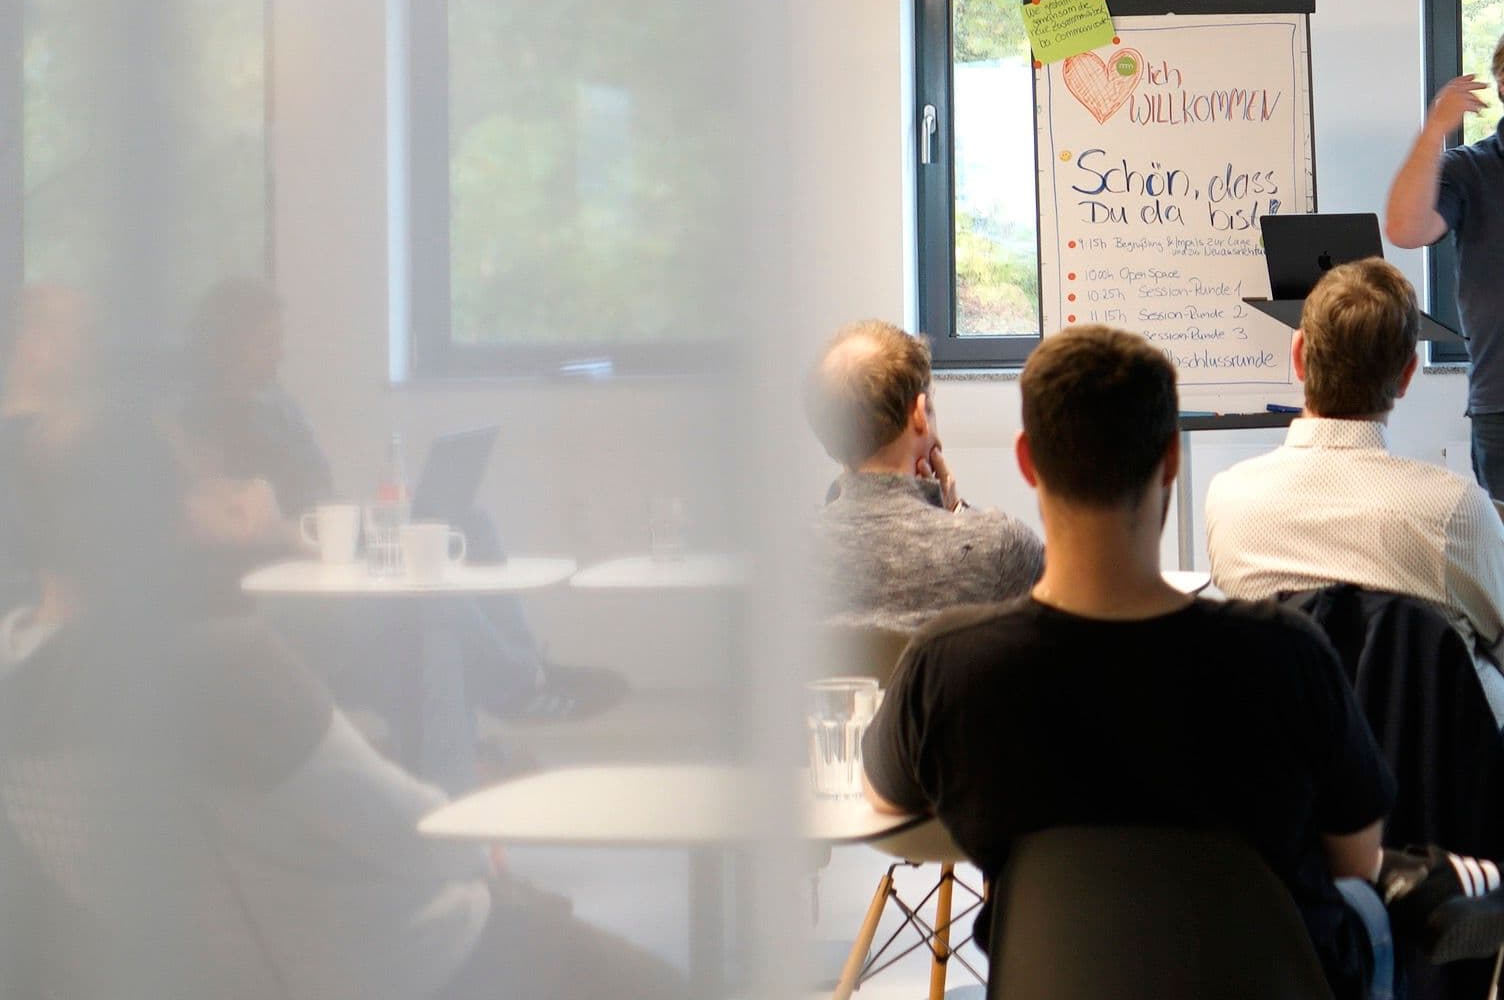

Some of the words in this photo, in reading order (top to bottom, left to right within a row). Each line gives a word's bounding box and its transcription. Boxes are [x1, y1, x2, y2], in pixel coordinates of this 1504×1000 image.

[1147, 60, 1182, 89] lich
[1129, 87, 1281, 126] WILLKOMMEN
[1072, 149, 1199, 200] Schön,
[1208, 162, 1278, 203] dass
[1078, 200, 1128, 225] Du
[1141, 199, 1185, 226] da
[1233, 304, 1248, 319] 2
[1233, 326, 1248, 340] 3
